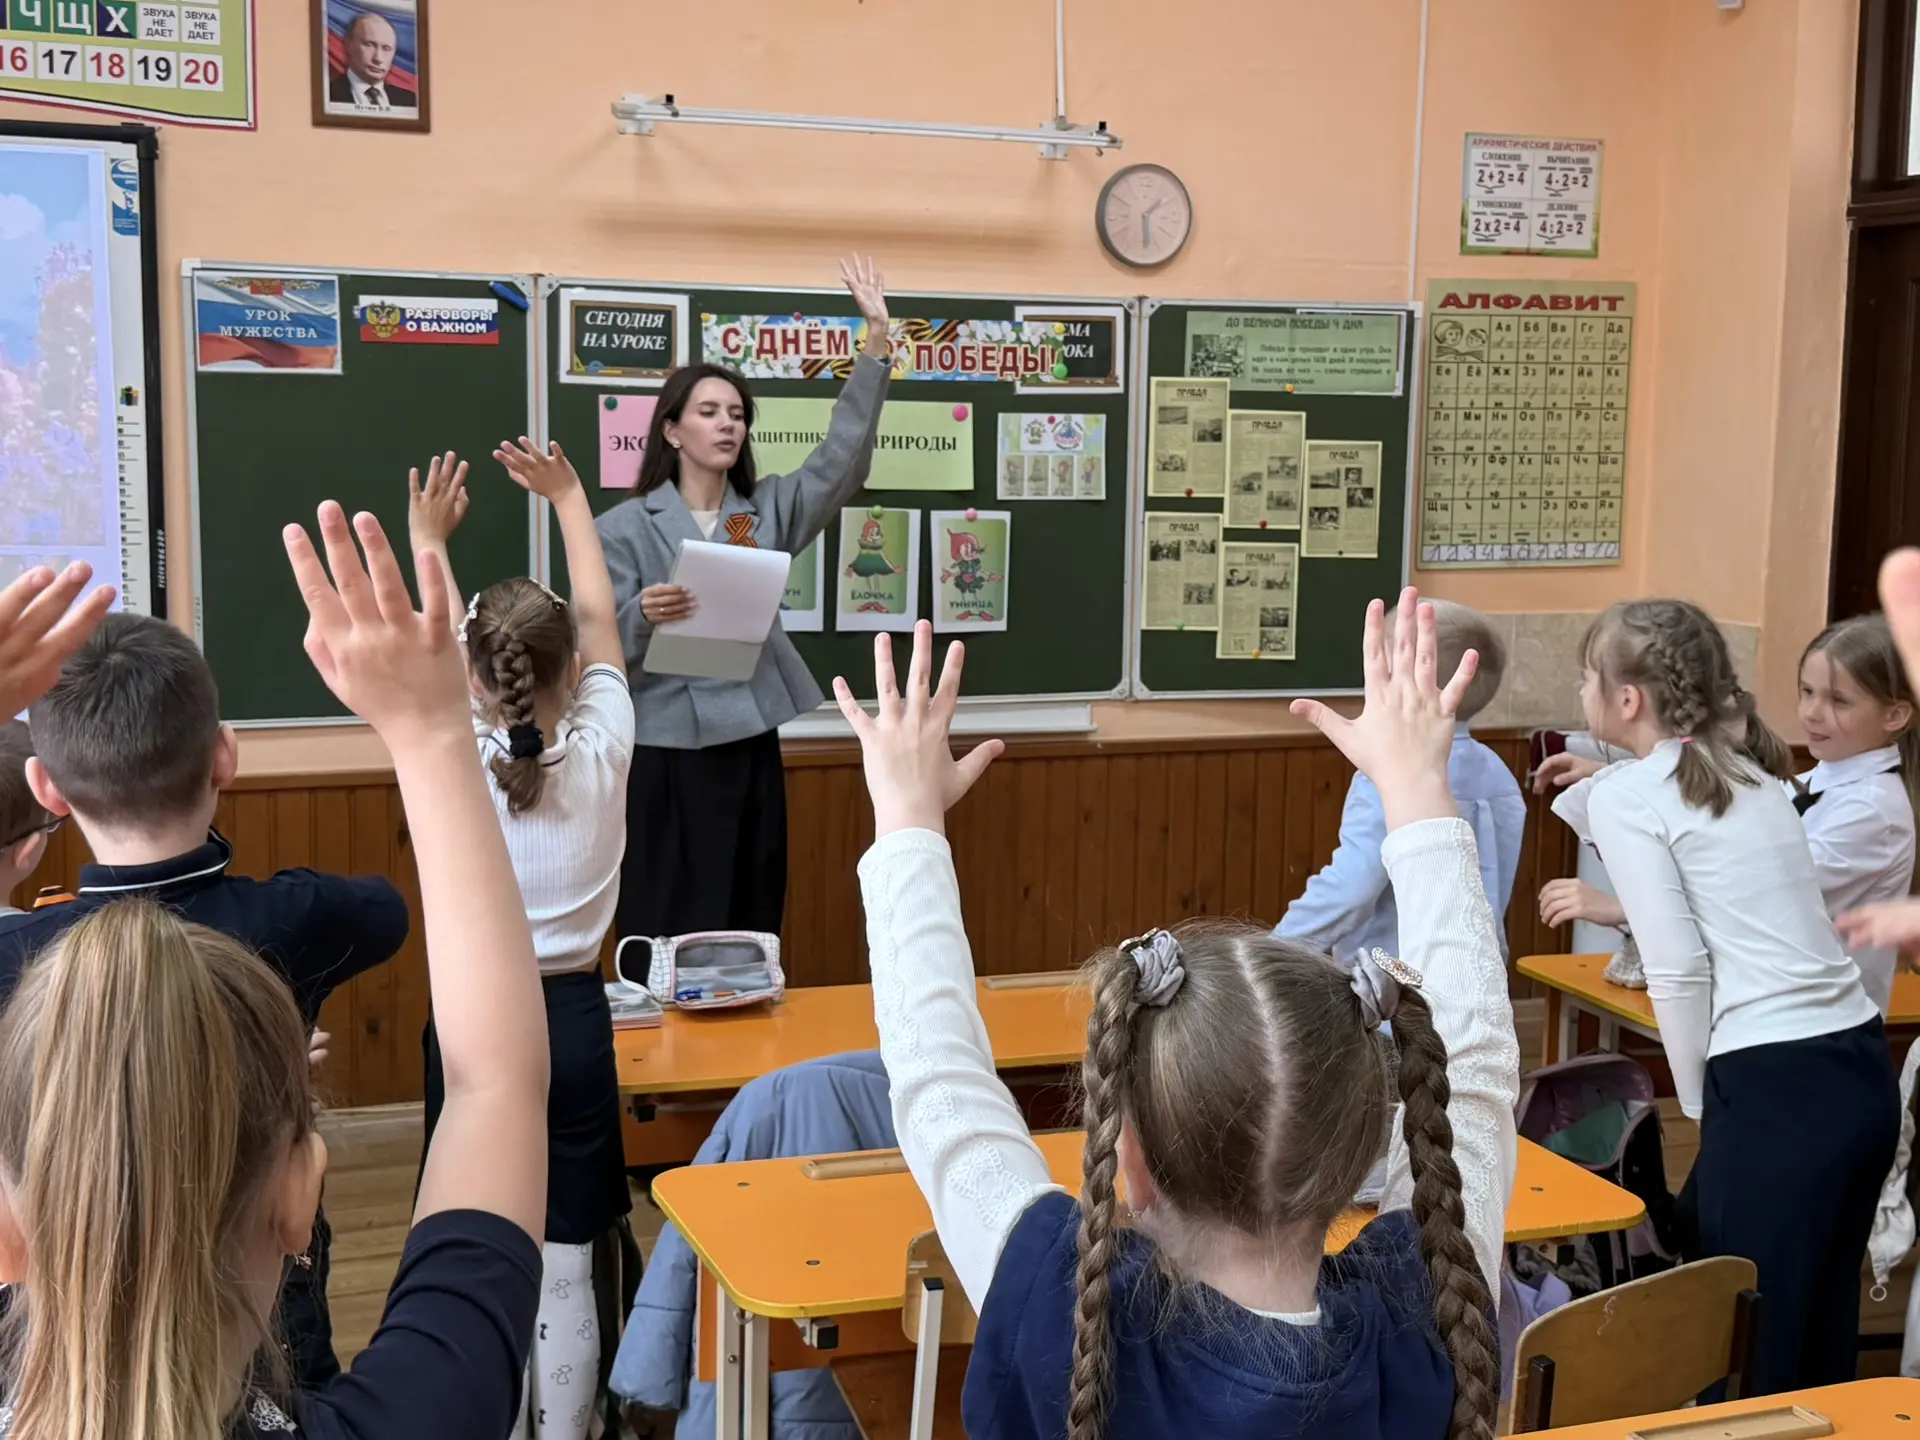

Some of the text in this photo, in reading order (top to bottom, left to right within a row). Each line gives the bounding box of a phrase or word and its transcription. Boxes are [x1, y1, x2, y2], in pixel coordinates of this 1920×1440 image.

[19, 0, 129, 34] Ч Щ Х
[143, 8, 176, 18] ЗВУКА
[184, 10, 217, 21] ЗВУКА
[153, 19, 166, 27] НЕ
[194, 22, 208, 30] НЕ
[146, 28, 172, 37] ДАЕТ
[187, 31, 214, 40] ДАЕТ
[42, 48, 77, 75] 17
[90, 52, 125, 78] 18
[137, 55, 172, 82] 19
[184, 59, 219, 85] 20
[1438, 293, 1624, 311] АЛФАВИТ
[245, 309, 291, 321] УРОК
[405, 308, 493, 321] РАЗГОВОРЫ
[585, 310, 665, 329] СЕГОДНЯ
[406, 321, 487, 333] О ВАЖНОМ
[1225, 317, 1240, 328] ДО
[219, 325, 318, 339] МУЖЕСТВА
[582, 333, 667, 350] НА УРОКЕ
[722, 322, 849, 361] С ДНЁМ
[608, 435, 649, 451] ЭКО
[749, 431, 828, 444] АЩИТНИК
